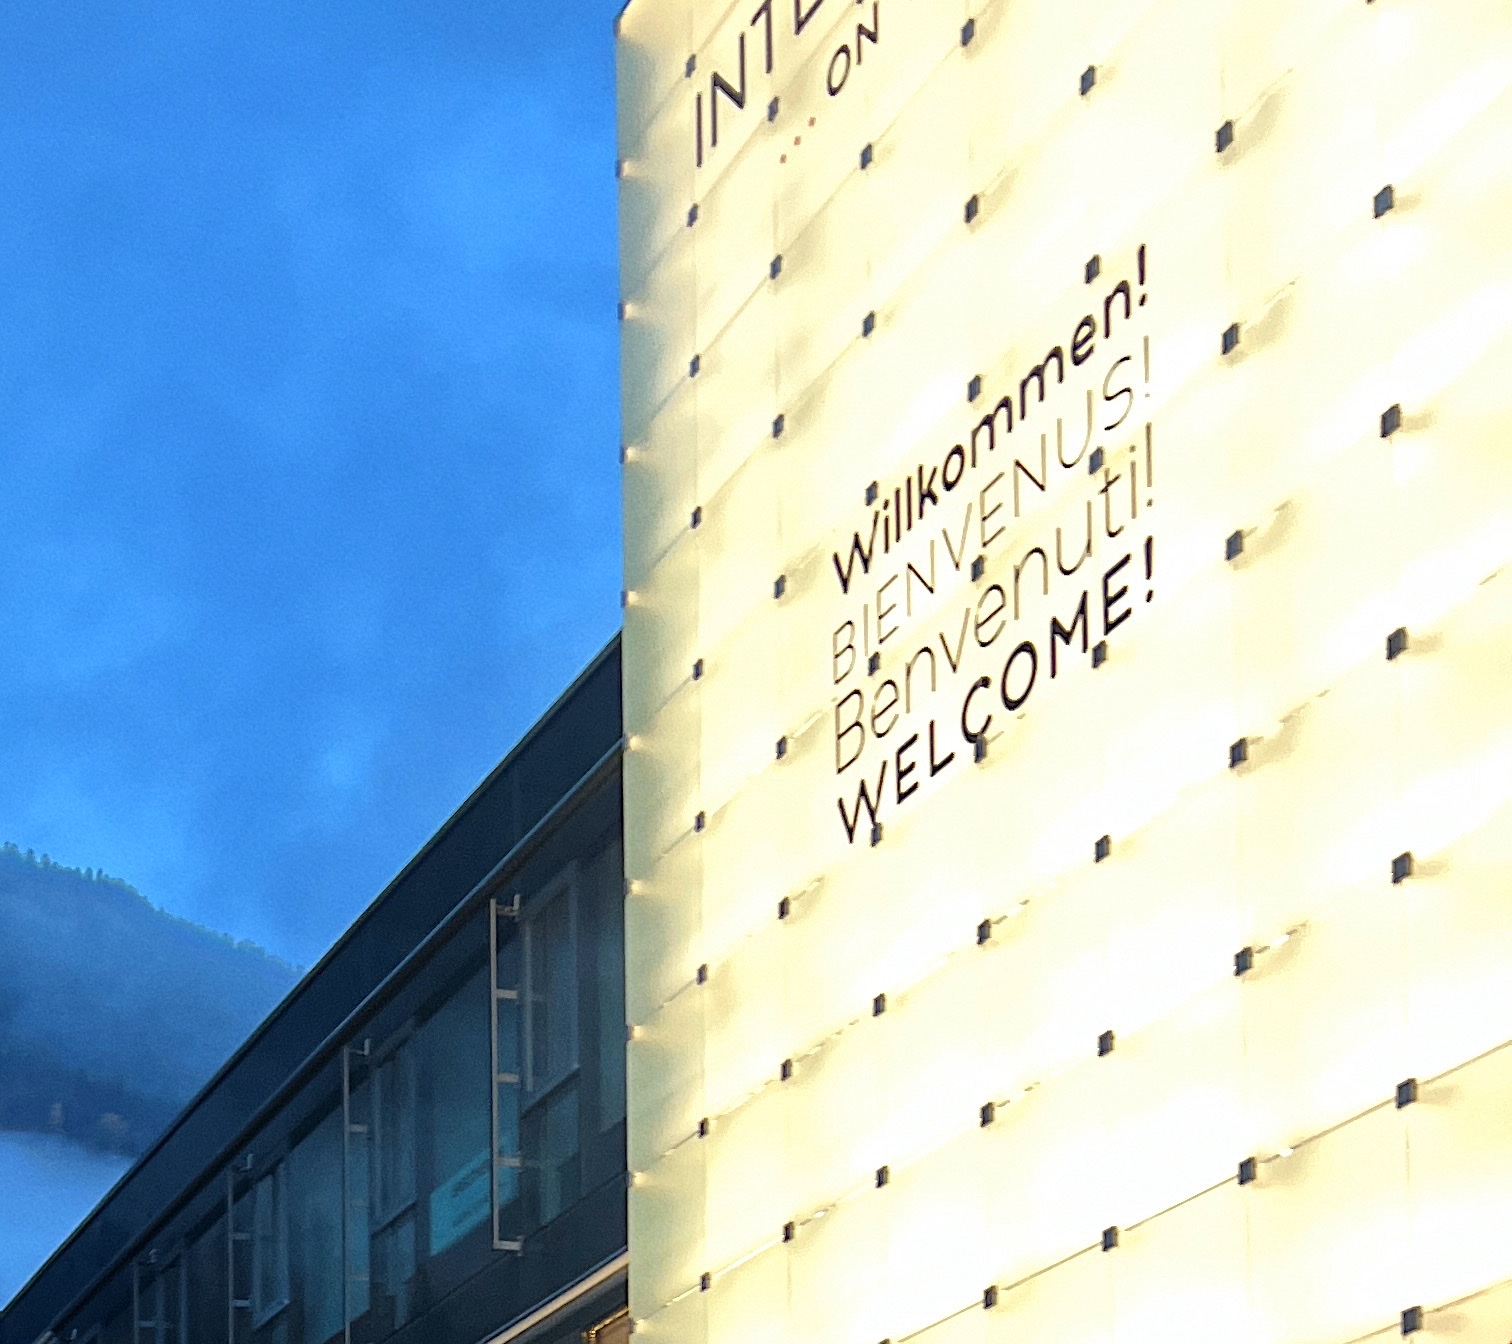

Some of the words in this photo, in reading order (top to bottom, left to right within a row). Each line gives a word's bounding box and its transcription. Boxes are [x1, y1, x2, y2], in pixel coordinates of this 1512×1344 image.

[832, 243, 1146, 594] Willkommen!
[833, 335, 1150, 684] BIENVENUS!
[835, 422, 1153, 774] Benvenuti!
[838, 536, 1153, 843] WELCOME!
